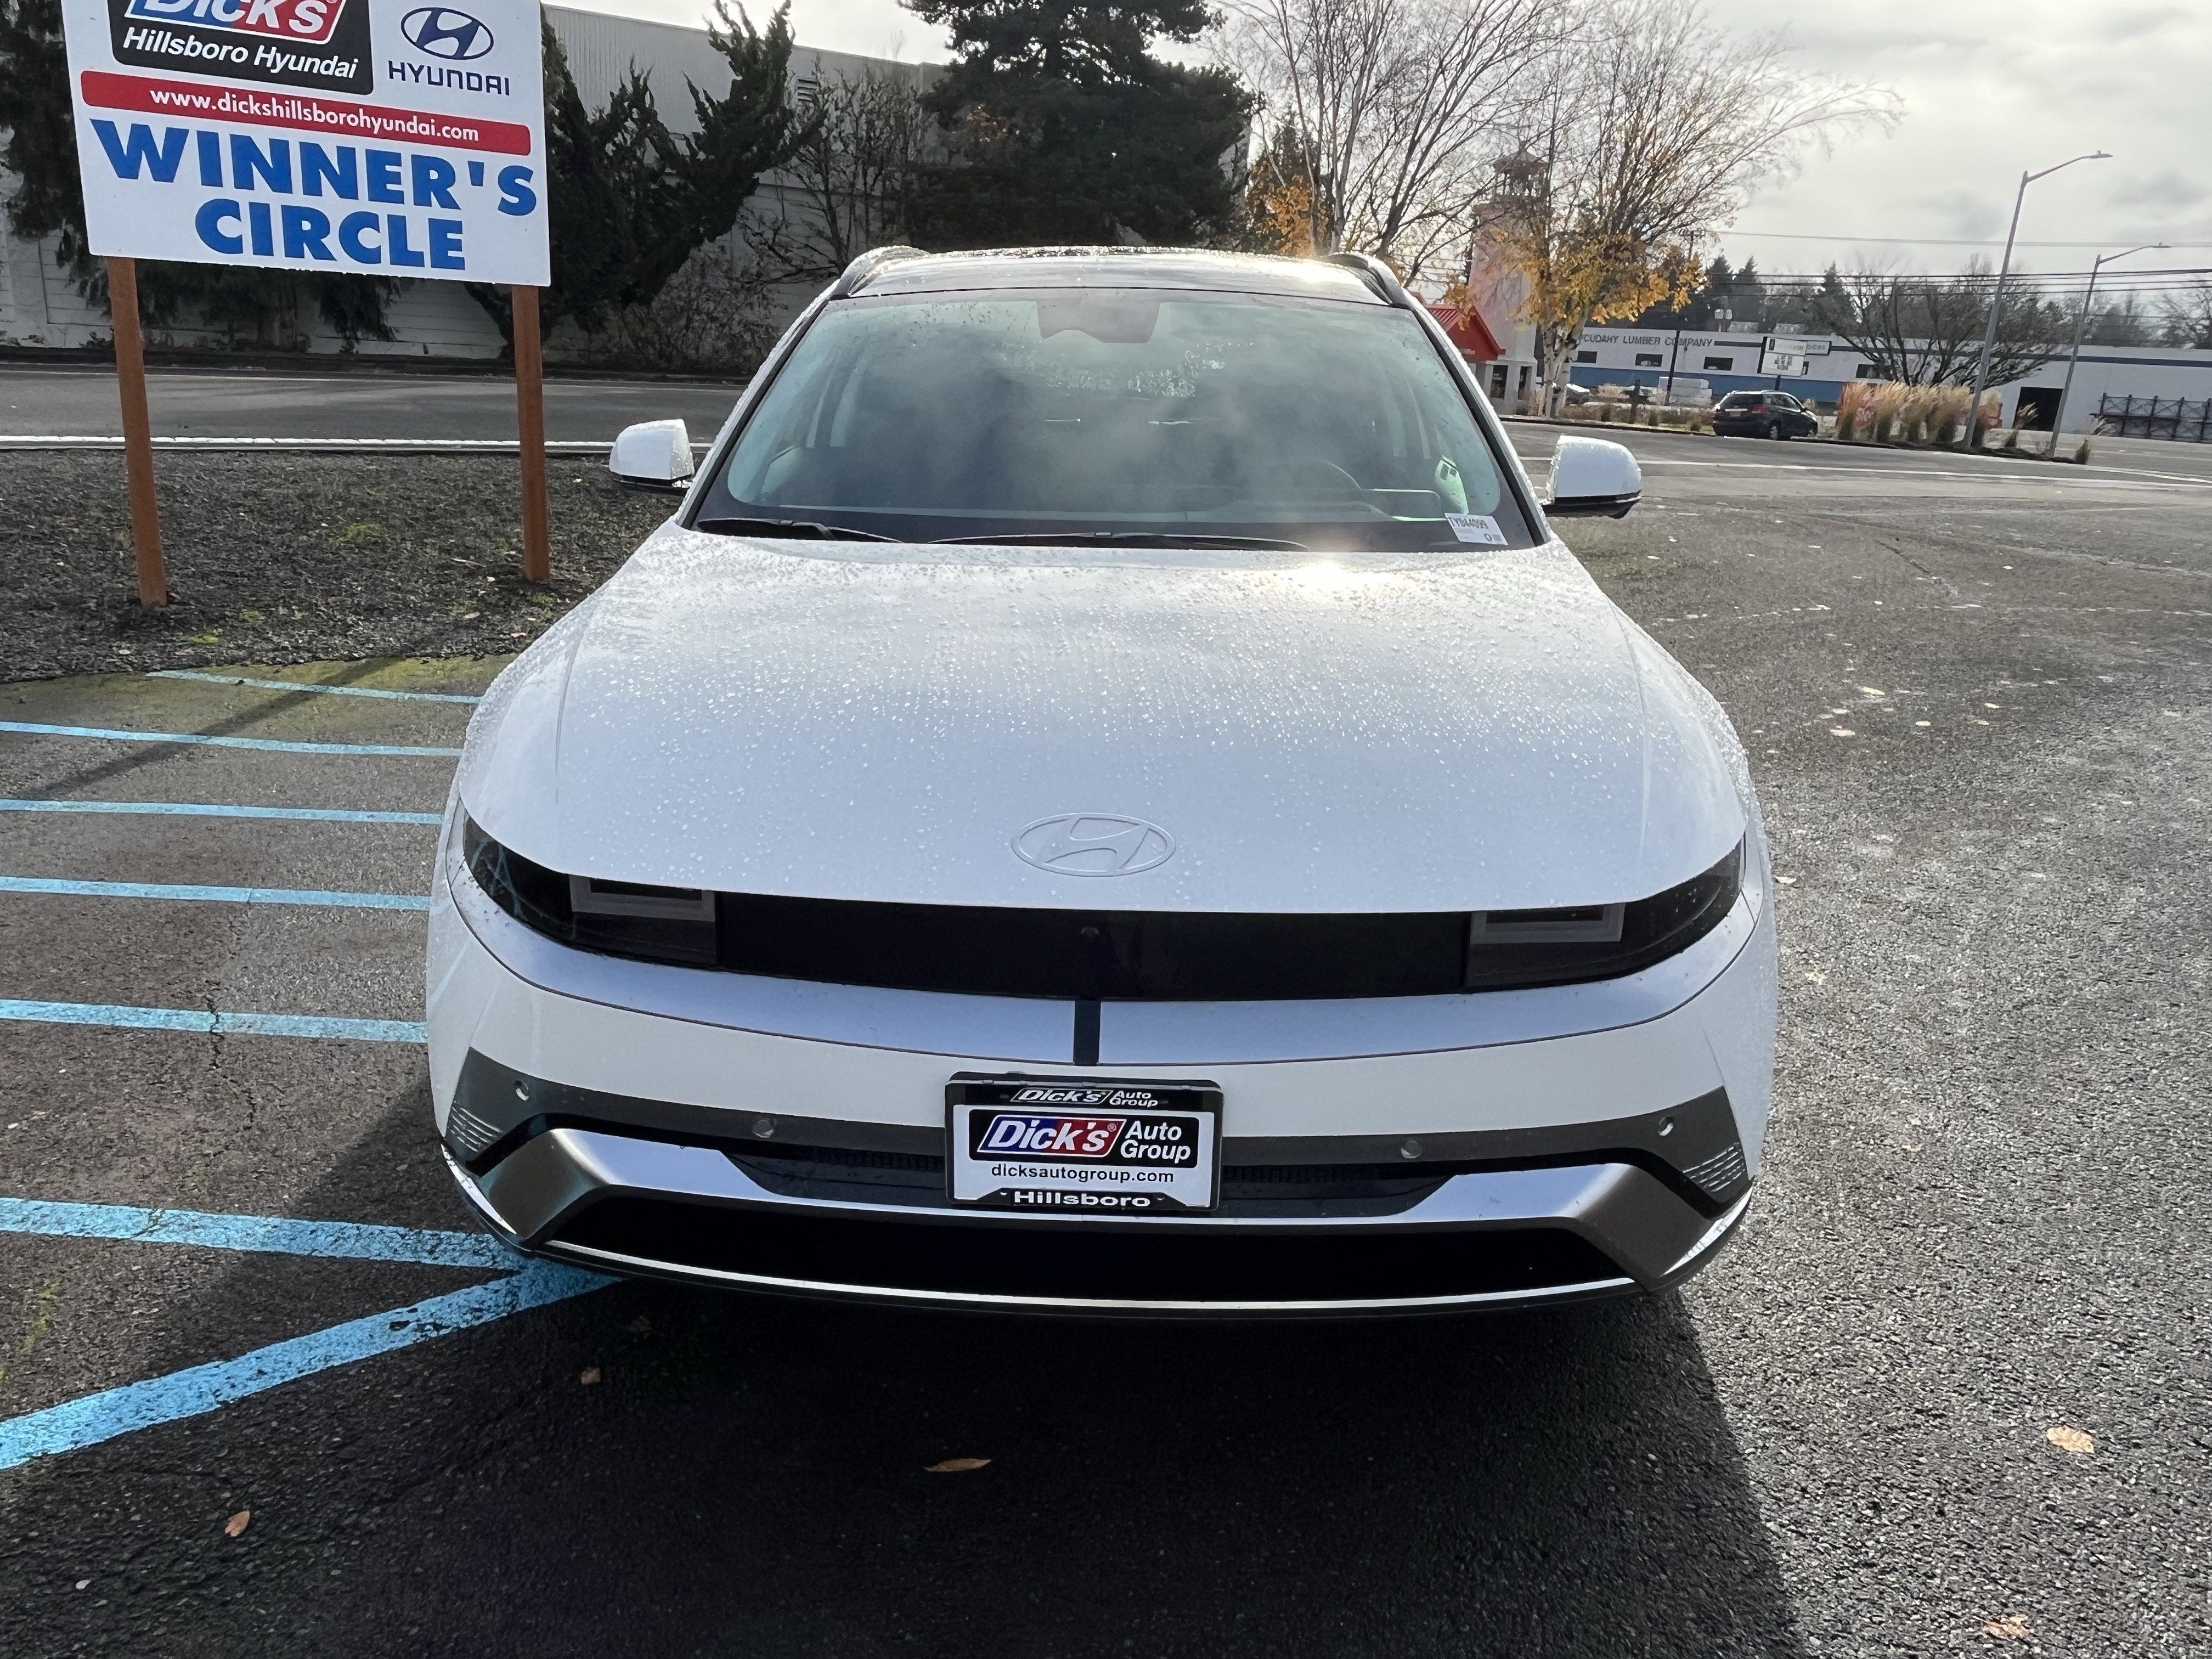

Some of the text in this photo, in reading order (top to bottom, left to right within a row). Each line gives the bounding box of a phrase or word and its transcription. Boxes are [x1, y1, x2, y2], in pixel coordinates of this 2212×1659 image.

[123, 26, 359, 80] Hillsboro Hyundai
[388, 60, 510, 96] HYUNDAI
[150, 90, 479, 142] www.dickshillsborohyundai.com
[89, 118, 537, 217] WINNER'S
[195, 198, 466, 271] CIRCLE
[1583, 334, 1619, 344] CUDAHY
[1623, 335, 1661, 346] LUMBER
[1018, 1090, 1102, 1103] Dick's
[1109, 1098, 1158, 1108] Group
[1110, 1090, 1152, 1099] Auto
[988, 1120, 1109, 1152] Dick's
[1125, 1120, 1182, 1141] Auto
[1120, 1139, 1191, 1164] Group
[991, 1164, 1173, 1183] dicksautogroup.com
[1014, 1191, 1150, 1206] Hillsboro
